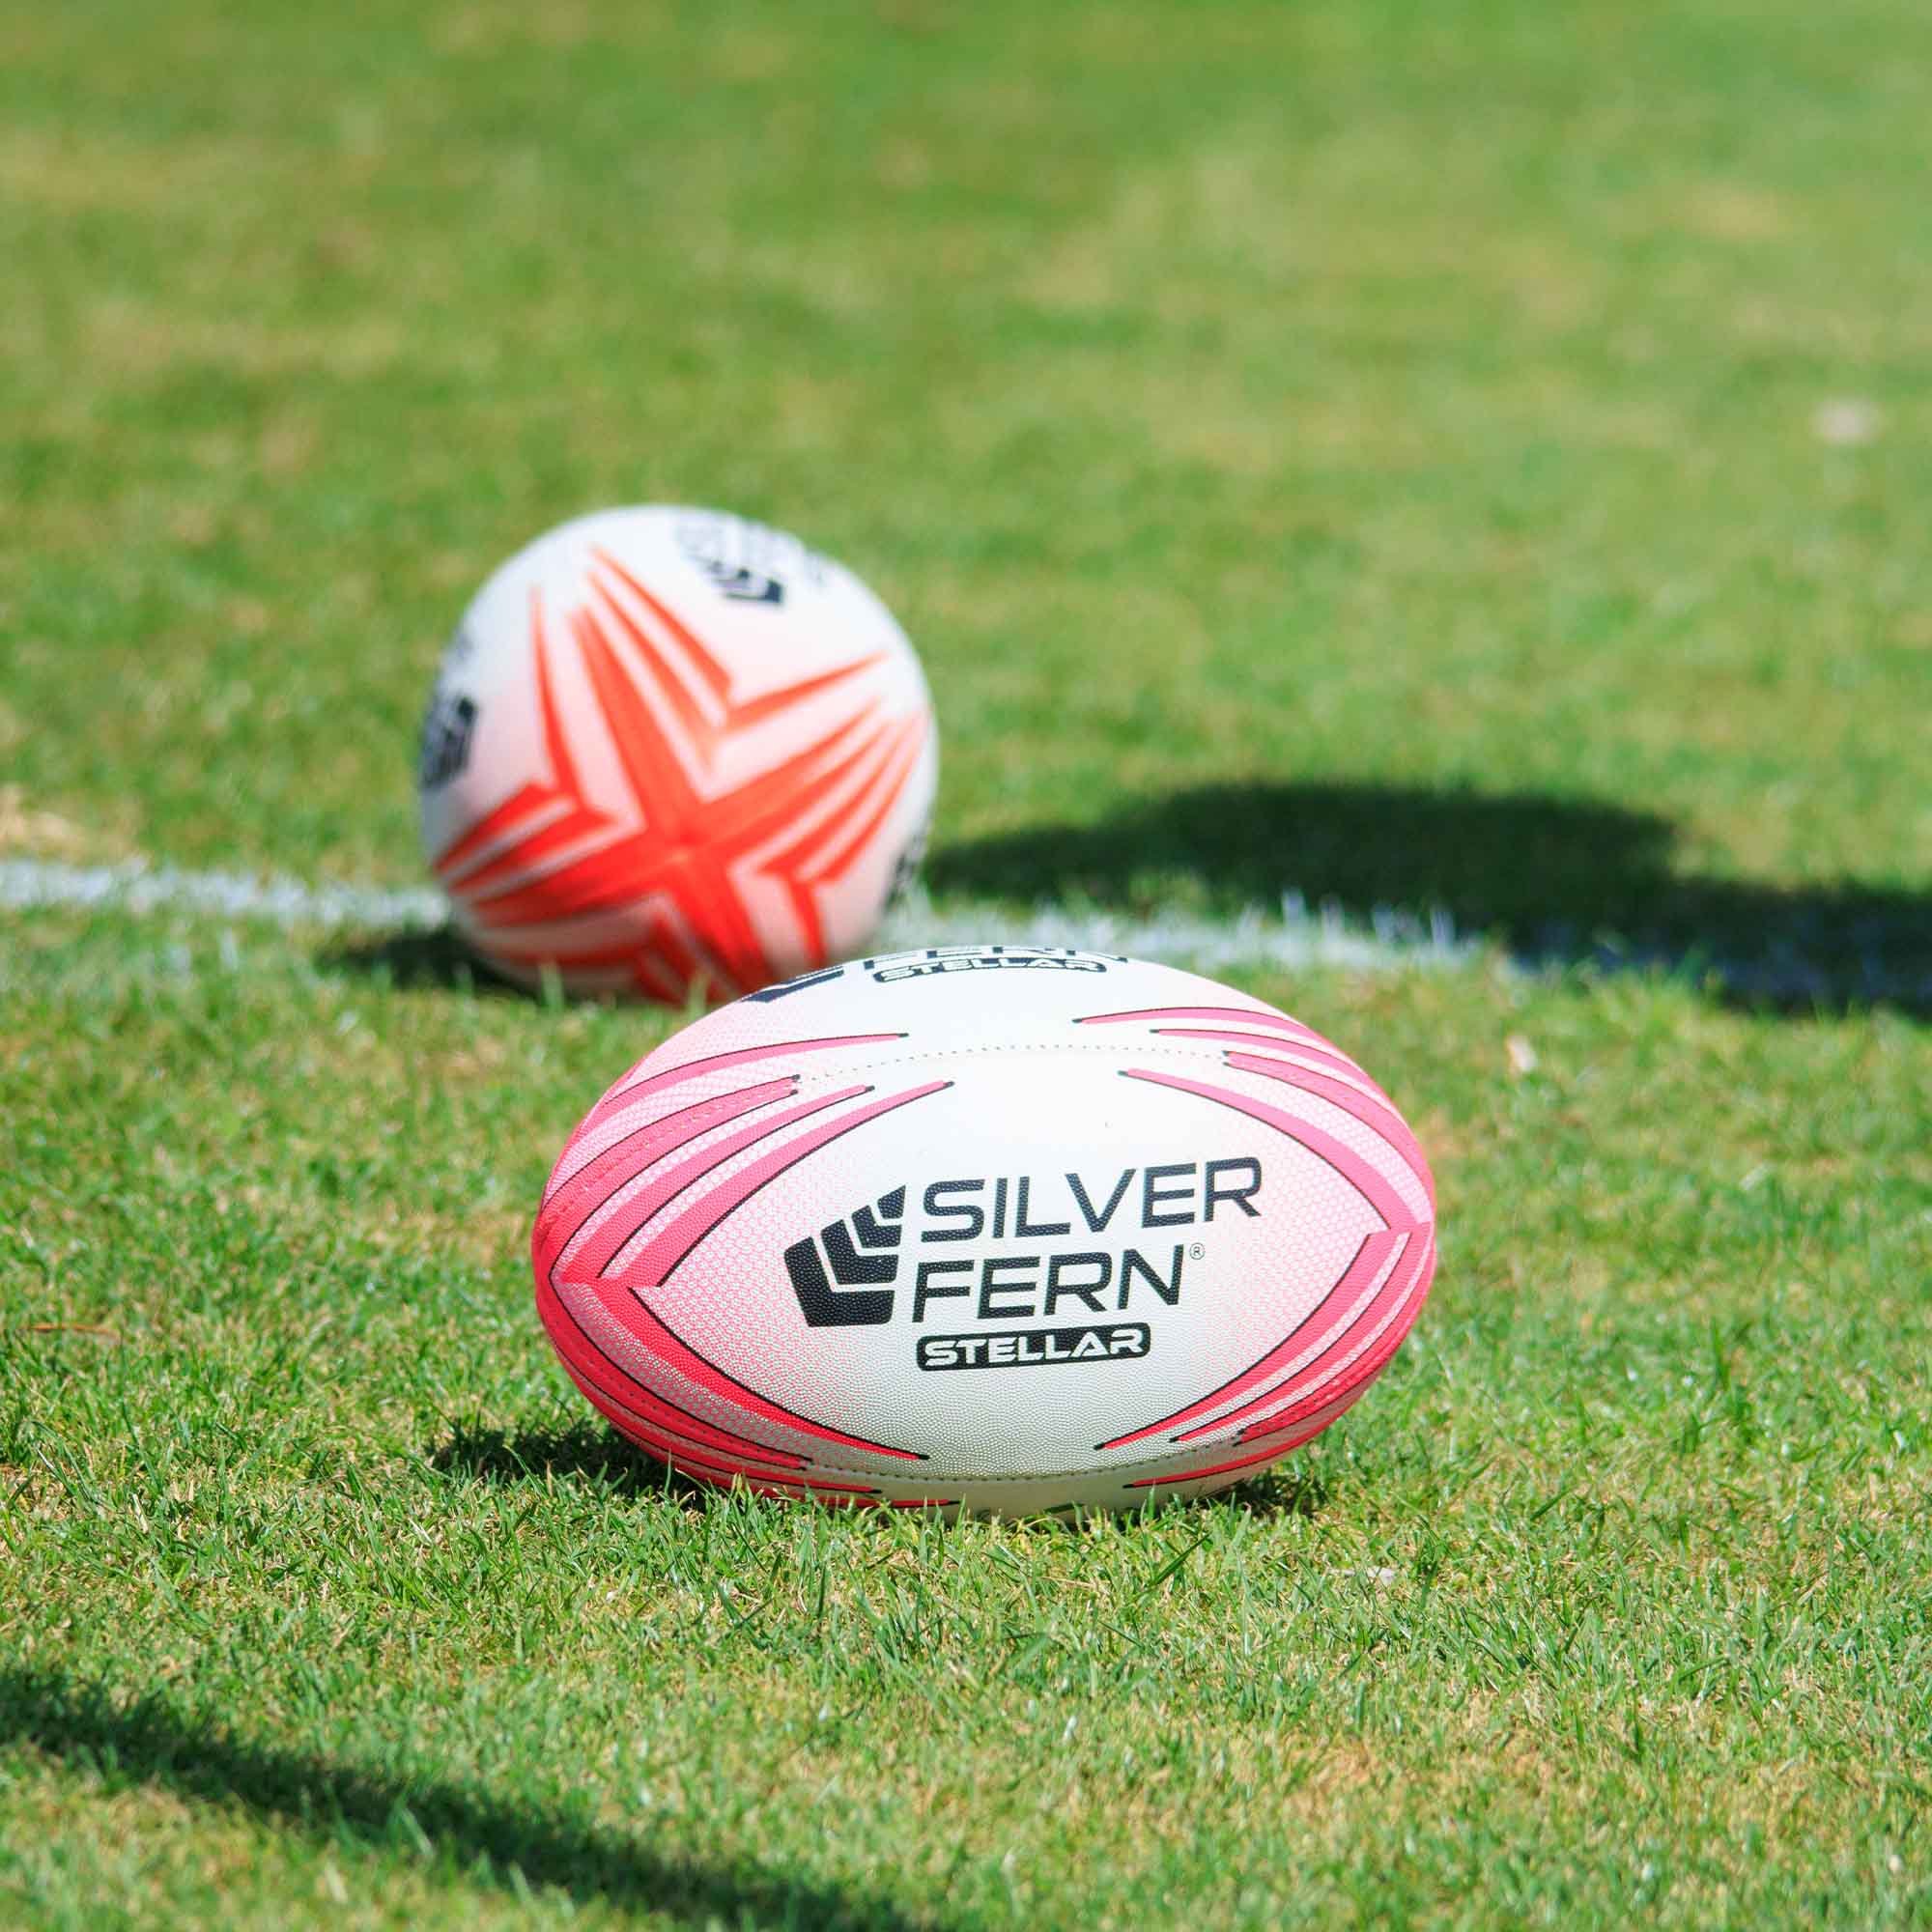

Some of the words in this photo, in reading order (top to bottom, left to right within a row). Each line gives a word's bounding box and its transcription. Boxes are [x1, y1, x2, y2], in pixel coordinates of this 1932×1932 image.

[880, 957, 1099, 980] STELLAR
[922, 1157, 1263, 1242] SILVER
[912, 1244, 1184, 1322] FERN
[923, 1328, 1144, 1367] STELLAR
